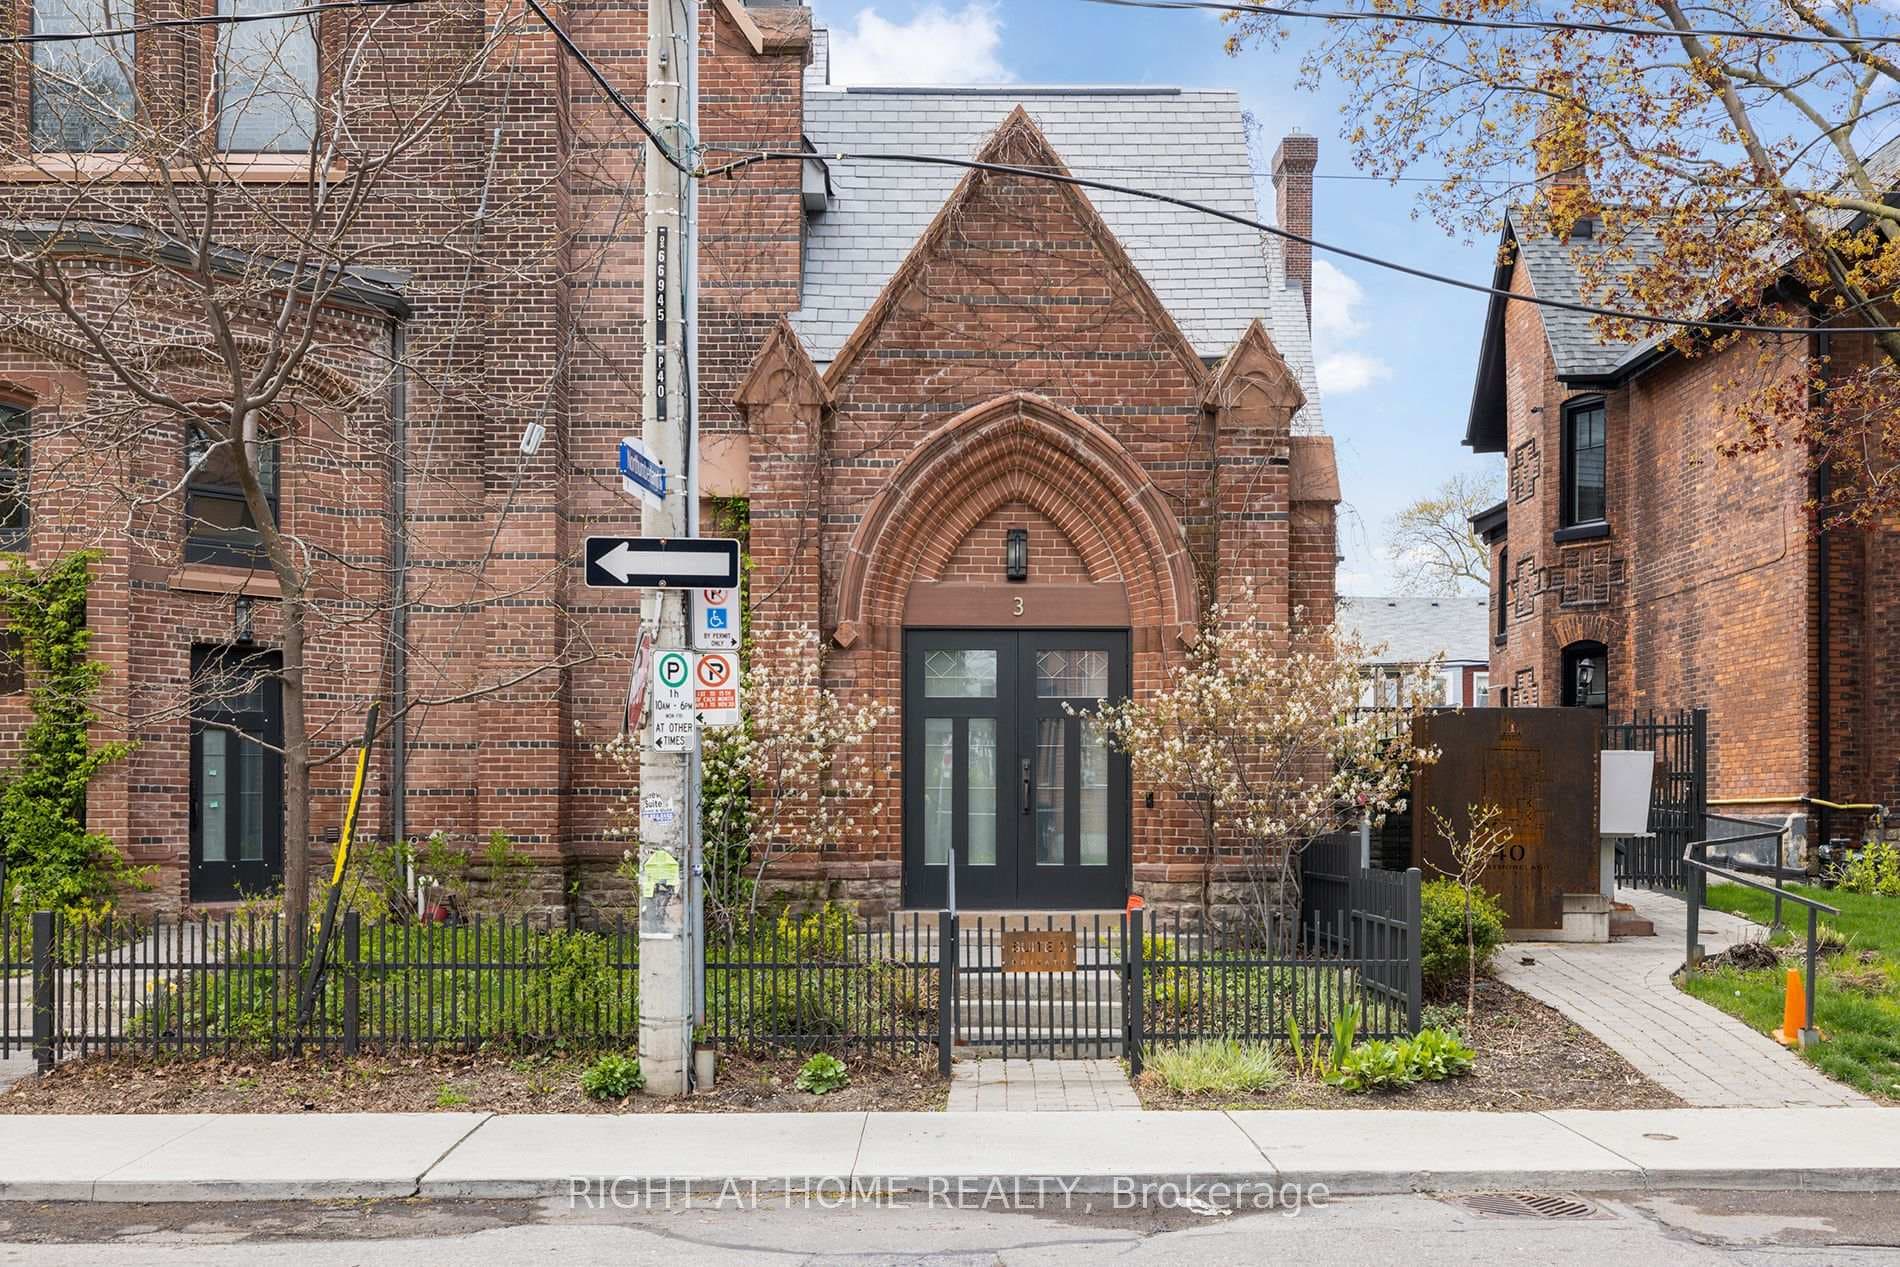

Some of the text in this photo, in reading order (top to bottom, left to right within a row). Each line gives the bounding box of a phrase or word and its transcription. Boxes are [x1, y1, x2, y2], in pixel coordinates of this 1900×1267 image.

[657, 250, 666, 321] 66945
[657, 356, 665, 397] P40
[1013, 596, 1024, 616] 3
[667, 662, 680, 680] P
[709, 662, 724, 681] P
[680, 701, 693, 710] 6PM
[656, 723, 693, 733] AT OTHER
[664, 736, 685, 746] TIMES
[1488, 844, 1526, 862] 40
[1012, 941, 1055, 953] SUITE
